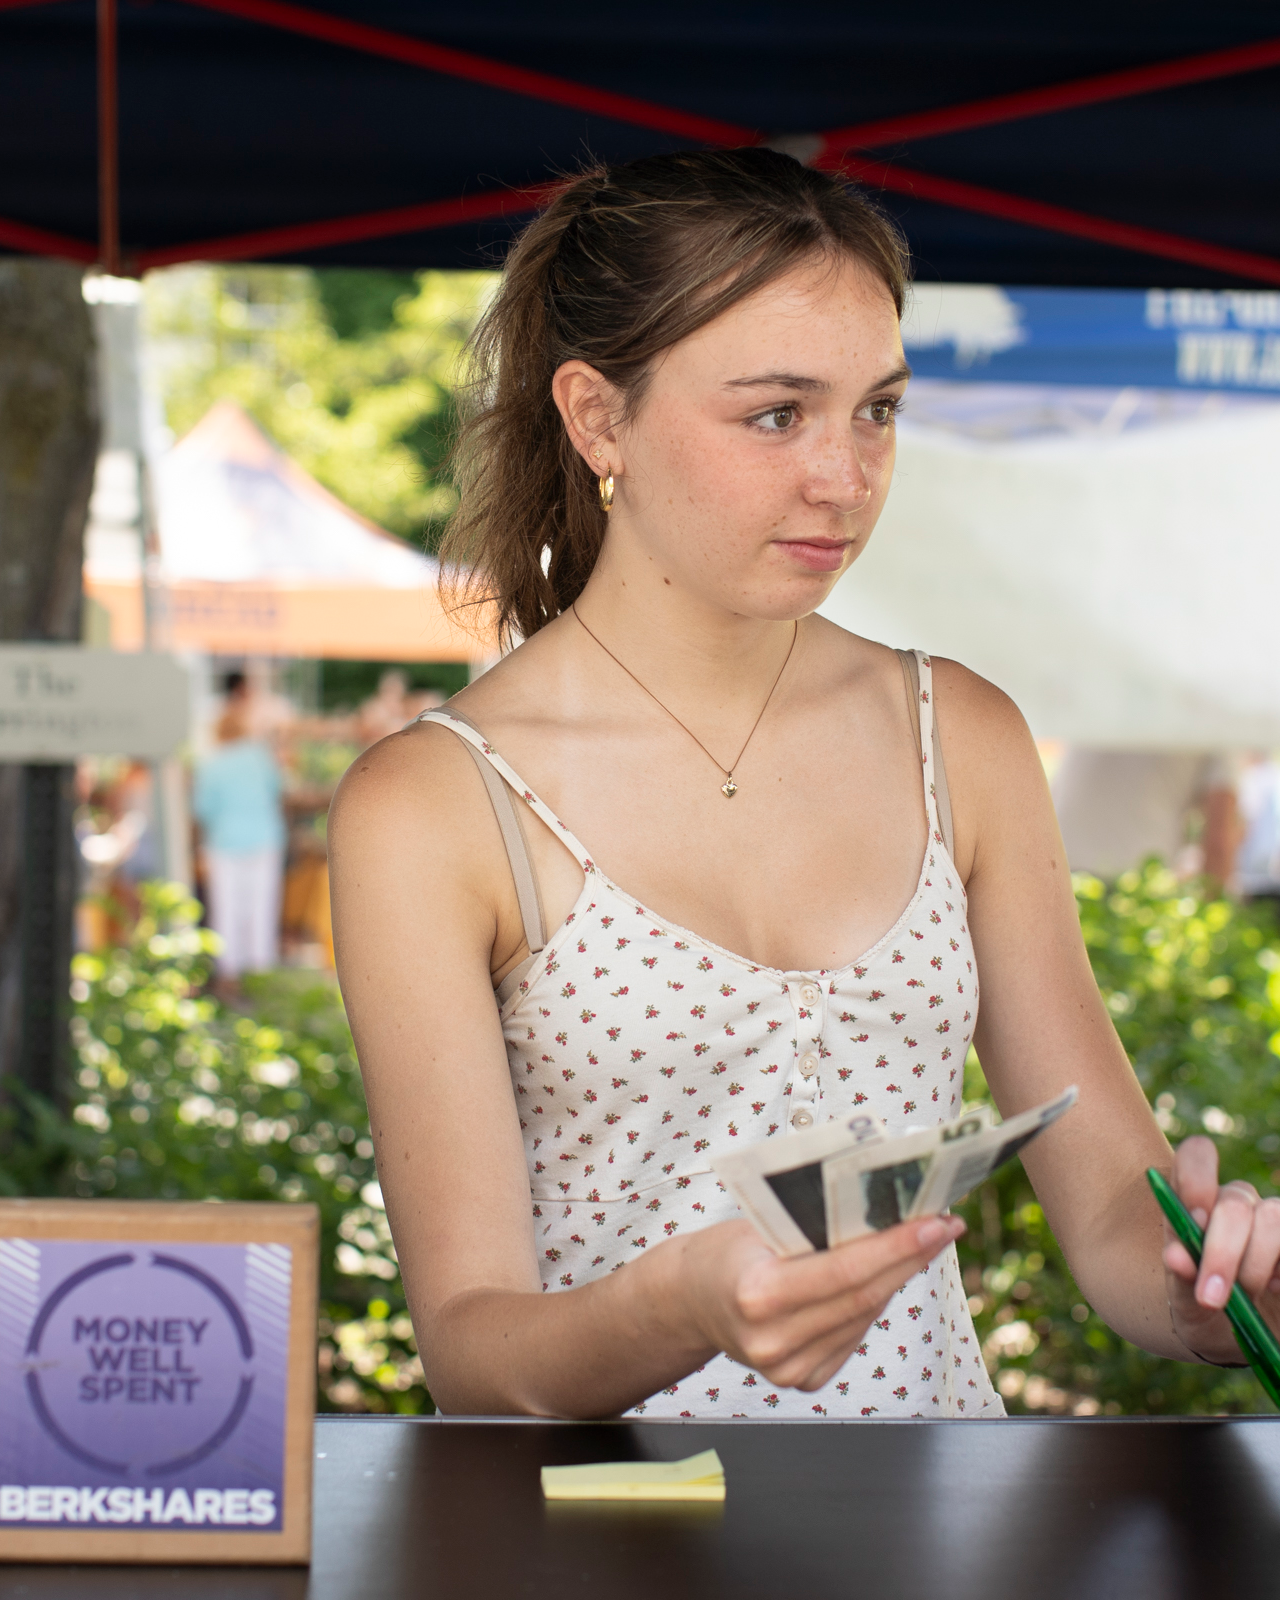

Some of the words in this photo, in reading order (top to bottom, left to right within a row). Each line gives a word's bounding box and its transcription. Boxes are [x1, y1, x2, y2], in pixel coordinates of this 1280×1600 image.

[72, 1316, 209, 1345] MONEY
[88, 1347, 195, 1374] WELL
[78, 1376, 201, 1404] SPENT
[0, 1485, 277, 1525] BERKSHARES
